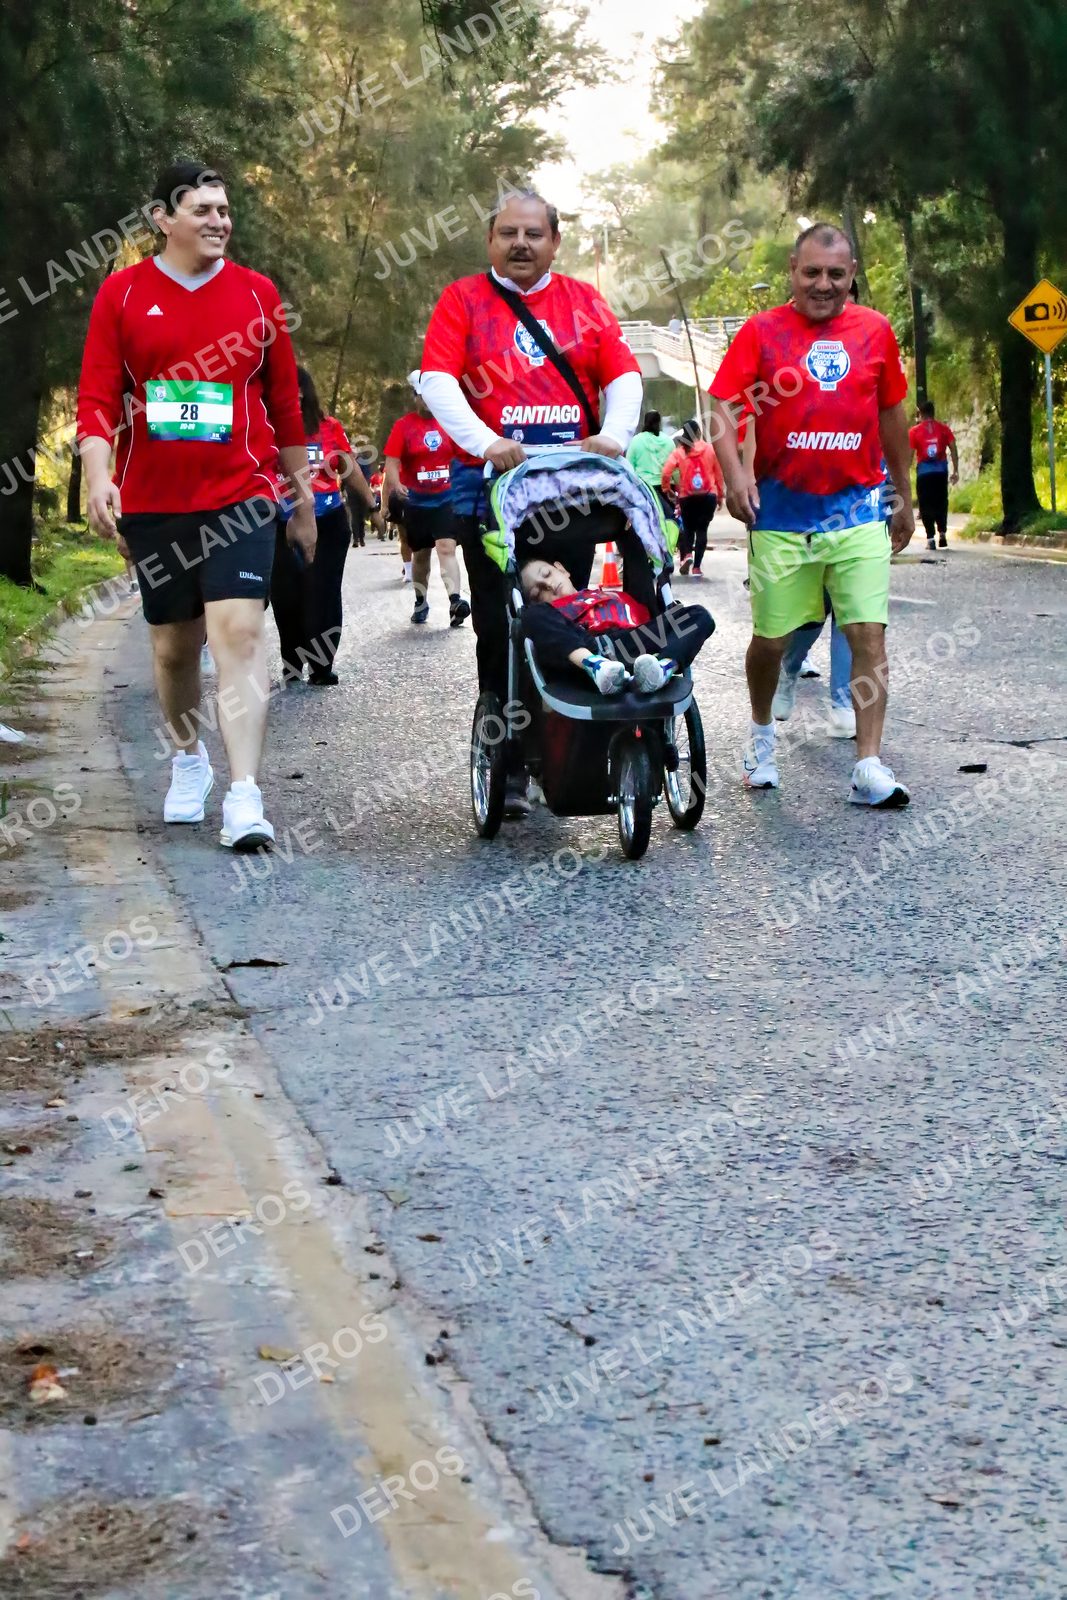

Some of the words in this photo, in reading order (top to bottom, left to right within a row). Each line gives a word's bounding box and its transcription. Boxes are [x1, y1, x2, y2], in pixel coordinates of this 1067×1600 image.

[180, 403, 199, 420] 28
[500, 405, 581, 425] SANTIAGO
[786, 431, 863, 451] SANTIAGO
[239, 571, 264, 582] Wilson
